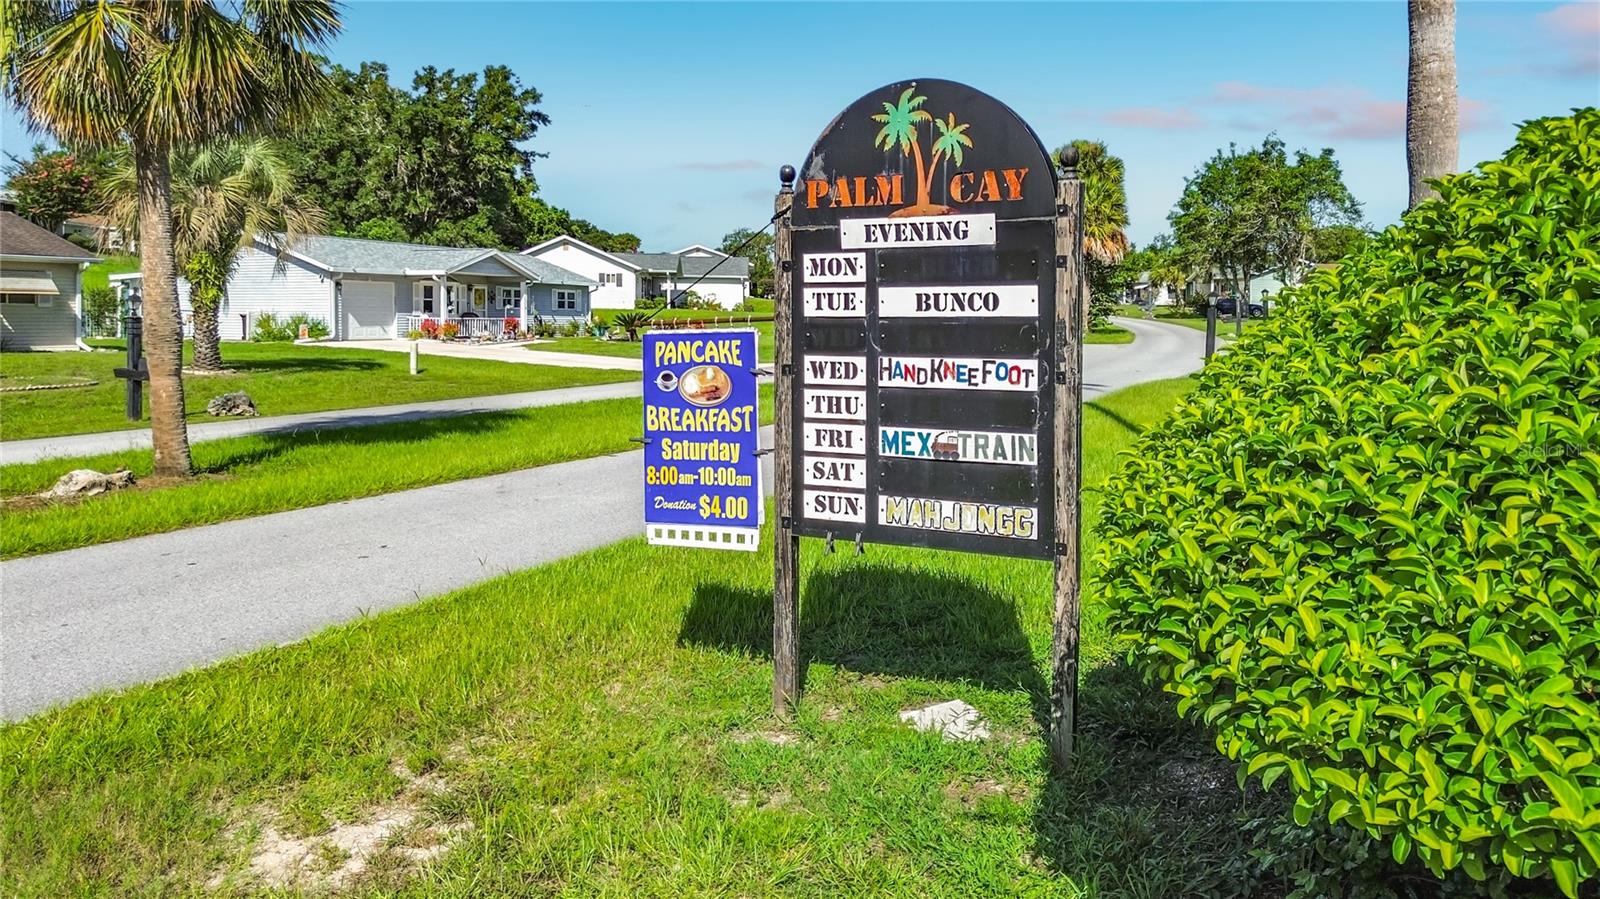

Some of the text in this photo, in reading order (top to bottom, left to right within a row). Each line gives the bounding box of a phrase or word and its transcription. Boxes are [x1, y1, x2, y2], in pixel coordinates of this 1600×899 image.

[805, 168, 1029, 209] PALM CAY
[864, 220, 969, 243] EVENING
[809, 257, 858, 277] MON
[812, 292, 857, 311] TUE
[915, 292, 1000, 313] BUNCO
[655, 339, 742, 367] PANCAKE
[809, 361, 858, 380] WED
[811, 395, 858, 415] THU
[647, 405, 754, 432] BREAKFAST
[814, 429, 853, 448] FRI
[881, 430, 1035, 462] MEX TRAIN
[661, 438, 740, 464] Saturday
[812, 461, 855, 481] SAT
[654, 494, 748, 519] Donation $4.00
[814, 495, 859, 516] SUN
[885, 496, 1034, 539] MAHJONGG
